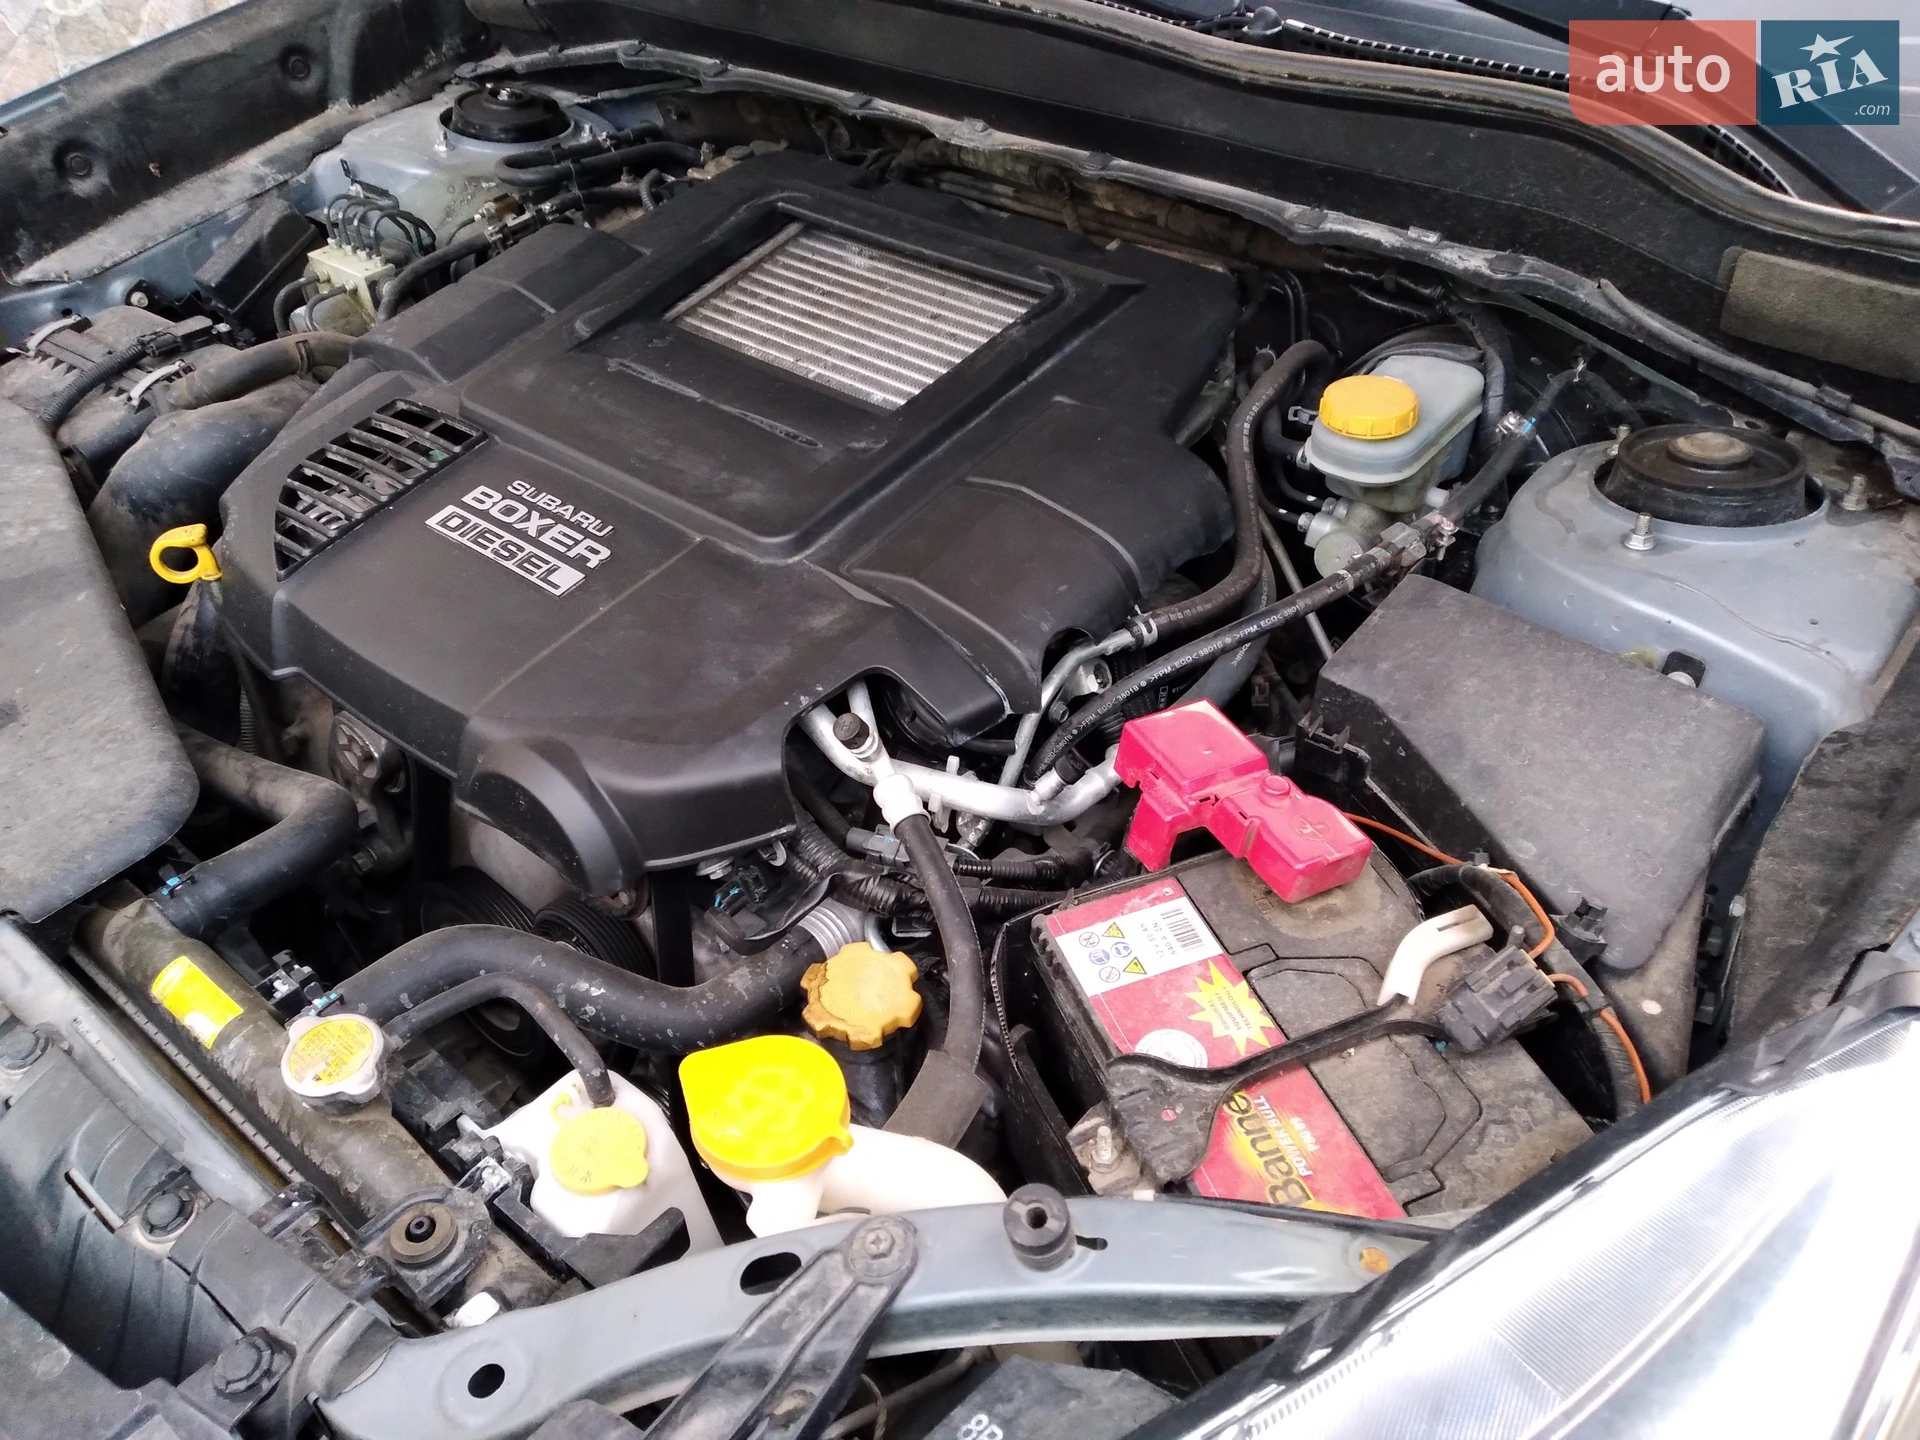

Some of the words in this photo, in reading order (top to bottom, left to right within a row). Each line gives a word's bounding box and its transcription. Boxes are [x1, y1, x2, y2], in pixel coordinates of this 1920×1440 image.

[461, 485, 612, 570] BOXER
[507, 480, 614, 537] SUBARU
[436, 511, 561, 590] DIESEL
[1207, 999, 1230, 1031] ORIGINAL
[1214, 992, 1242, 1031] EQUIPMENT
[1221, 986, 1252, 1029] TECHNOLOGY
[1253, 1095, 1281, 1128] BULL
[1223, 1092, 1312, 1205] Banne
[1274, 1127, 1313, 1177] POWER
